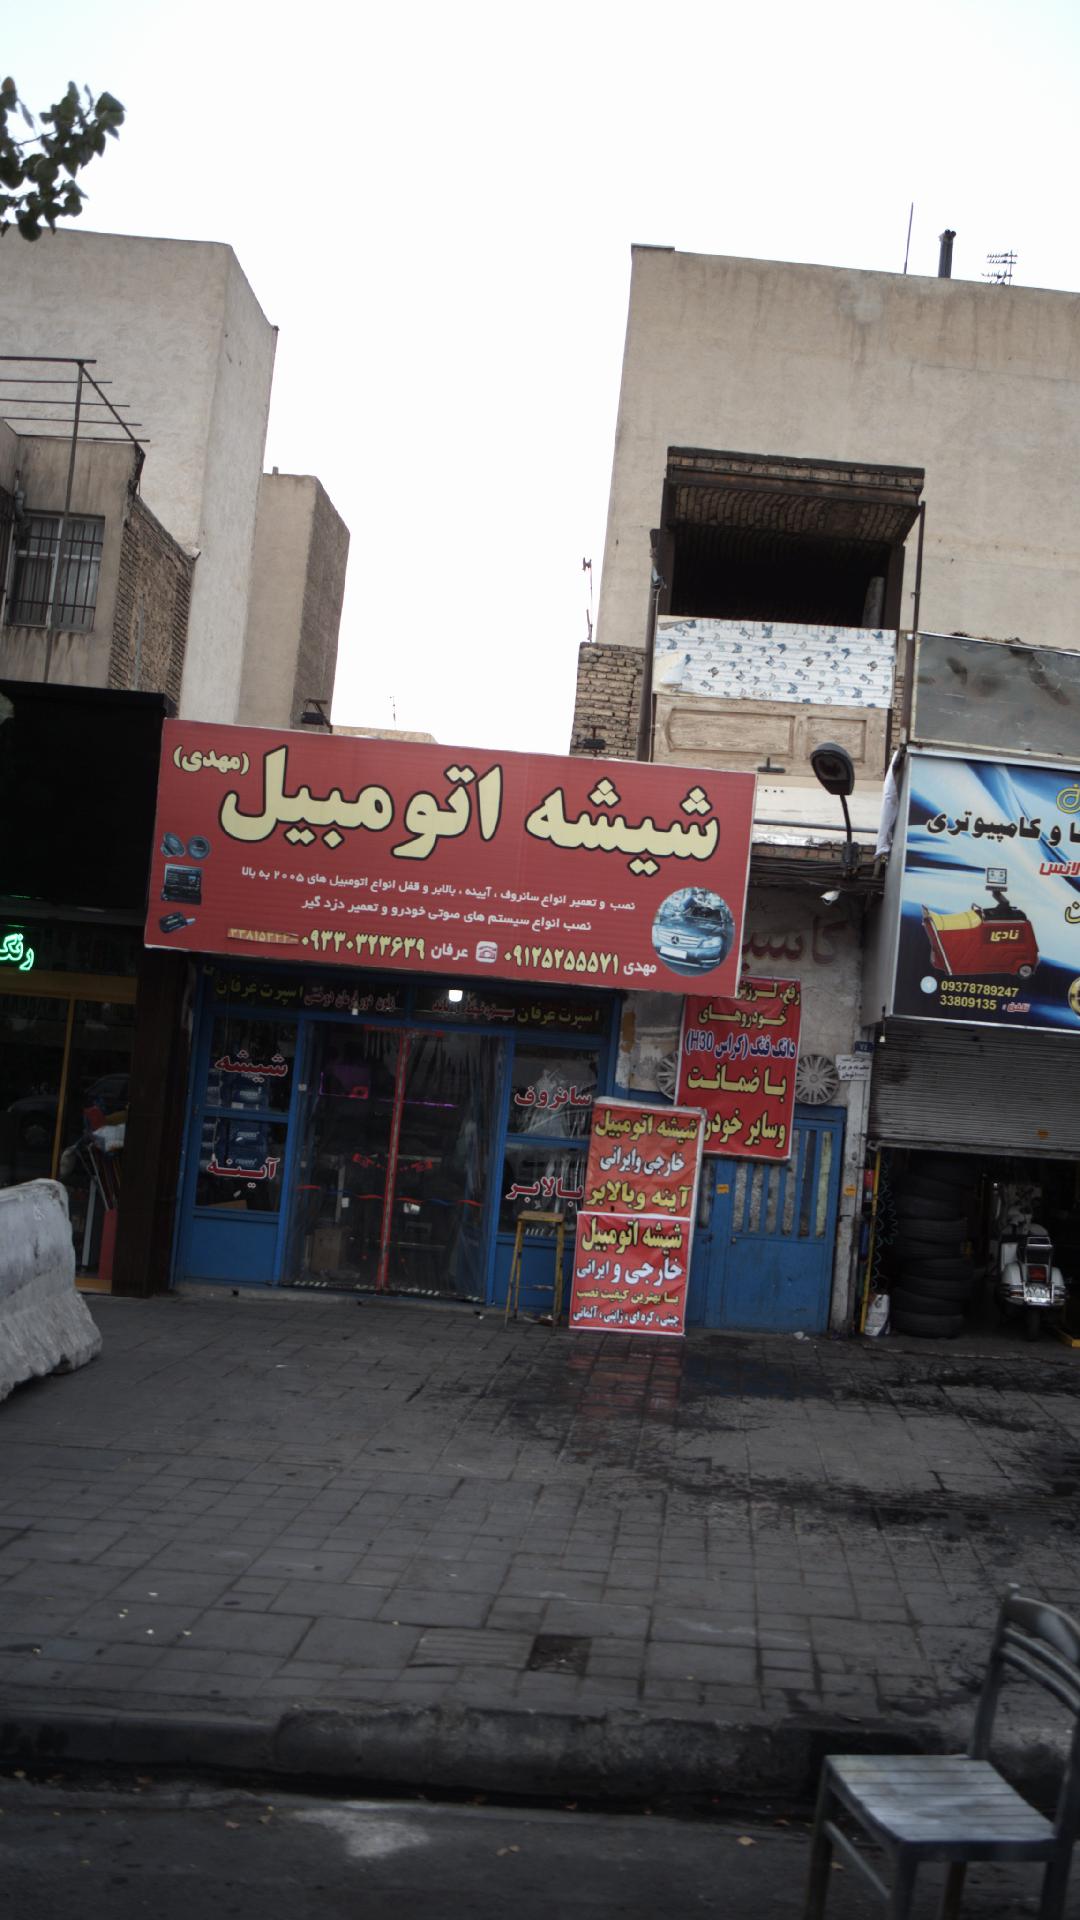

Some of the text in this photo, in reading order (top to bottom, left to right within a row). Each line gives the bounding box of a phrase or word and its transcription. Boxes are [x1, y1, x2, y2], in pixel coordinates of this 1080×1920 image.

[173, 745, 250, 775] (مهدی)
[219, 745, 719, 876] شیشه اتومبیل
[927, 810, 1041, 843] کامپیوتری
[1048, 825, 1061, 846] و
[241, 867, 256, 878] بالا
[259, 870, 270, 879] به
[1040, 860, 1080, 876] لانس
[274, 871, 304, 882] ۲۰۰۵
[307, 874, 327, 885] های
[329, 876, 368, 888] اتومبیل
[370, 879, 395, 892] انواع
[398, 881, 420, 892] قفل
[422, 884, 429, 895] و
[500, 889, 539, 902] سانروف
[541, 895, 566, 908] انواع
[348, 903, 379, 914] تعمیر
[381, 906, 387, 916] و
[391, 905, 426, 917] خودرو
[569, 898, 597, 909] تعمیر
[599, 900, 605, 910] و
[610, 901, 636, 911] نصب
[428, 907, 460, 920] صوتی
[464, 911, 485, 923] های
[488, 913, 529, 926] سیستم
[532, 917, 559, 932] انواع
[563, 921, 592, 931] نصب
[431, 943, 469, 960] عرفان
[504, 944, 657, 977] مهدی ۰۹۱۲۵۲۵۵۵۷۱
[738, 982, 778, 1002] لرز
[940, 980, 1019, 998] 09378789247
[940, 995, 997, 1011] 33809135
[699, 1003, 786, 1028] خودروهای
[214, 1049, 289, 1083] شیشه
[688, 1063, 787, 1102] با ضمانت
[514, 1085, 592, 1110] سانروف
[595, 1109, 698, 1144] شیشه اتومبیل
[704, 1108, 743, 1144] خودر
[644, 1151, 685, 1177] خارجی
[505, 1176, 584, 1208] بالابر
[651, 1185, 692, 1212] آینه
[582, 1216, 682, 1256] شیشه اتومبیل
[576, 1257, 682, 1286] خارجی و ایرانی
[576, 1288, 680, 1305] با بهترین کیفیت نصب
[573, 1305, 597, 1320] آلمانی
